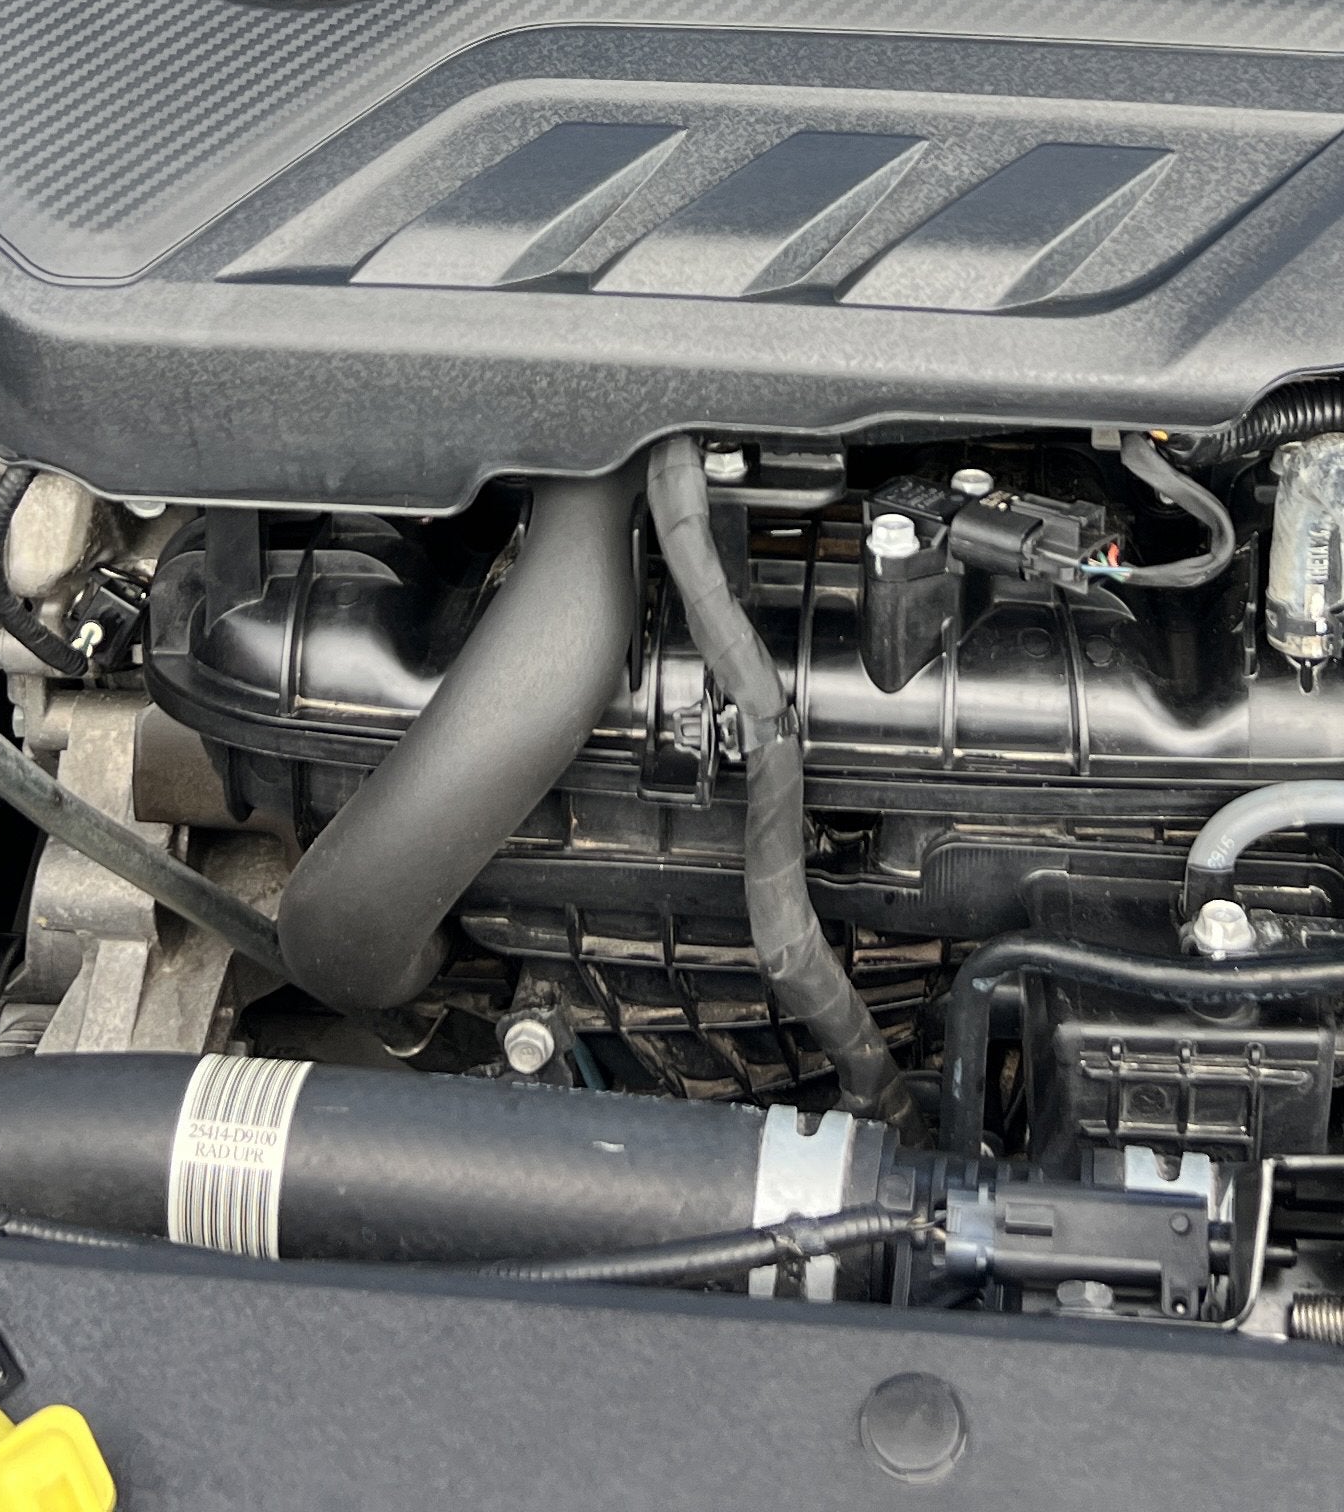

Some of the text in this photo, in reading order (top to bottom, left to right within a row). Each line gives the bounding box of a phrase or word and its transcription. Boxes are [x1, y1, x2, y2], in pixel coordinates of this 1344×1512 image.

[188, 1123, 278, 1147] 25414-D9100
[195, 1141, 265, 1164] RAD UPR
